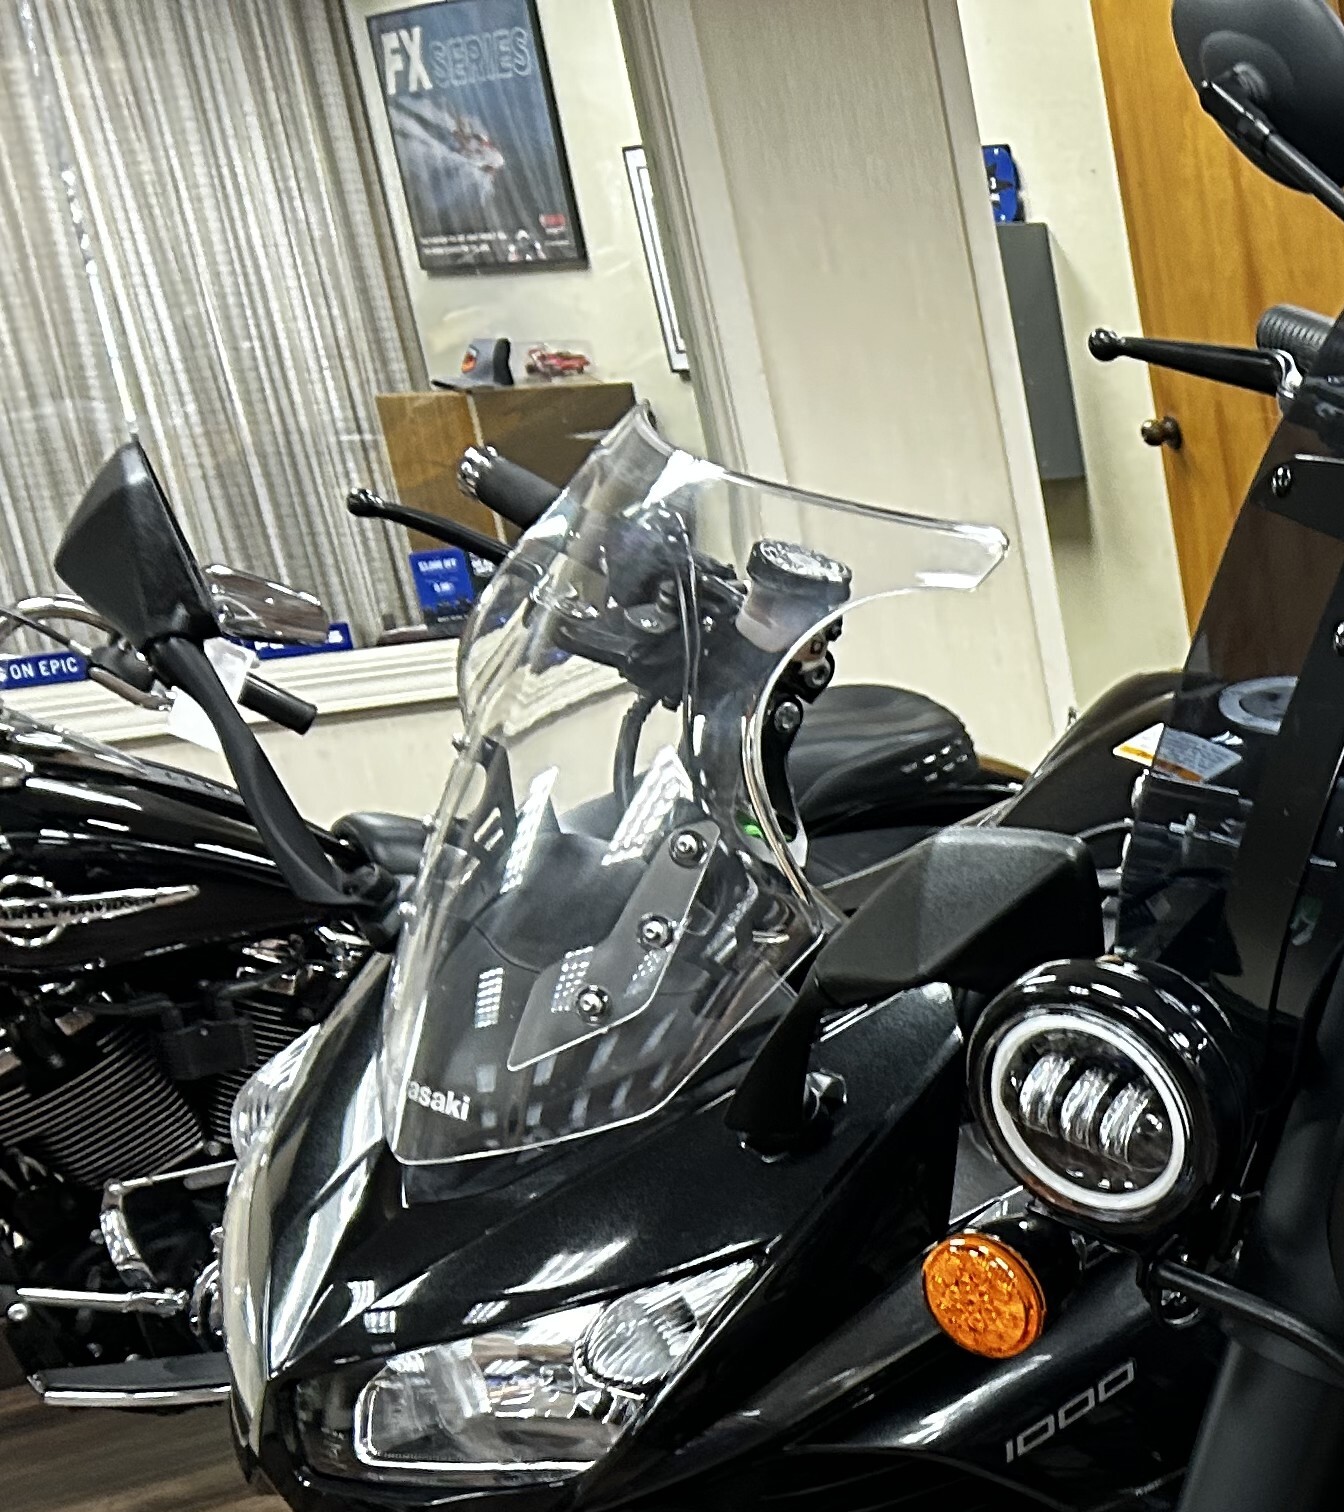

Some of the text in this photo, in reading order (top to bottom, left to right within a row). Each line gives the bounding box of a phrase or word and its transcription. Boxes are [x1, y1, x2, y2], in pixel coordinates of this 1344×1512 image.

[381, 26, 531, 95] FX SERIES
[9, 663, 35, 680] ON
[38, 656, 79, 677] EPIC
[1006, 1361, 1136, 1463] 1000
